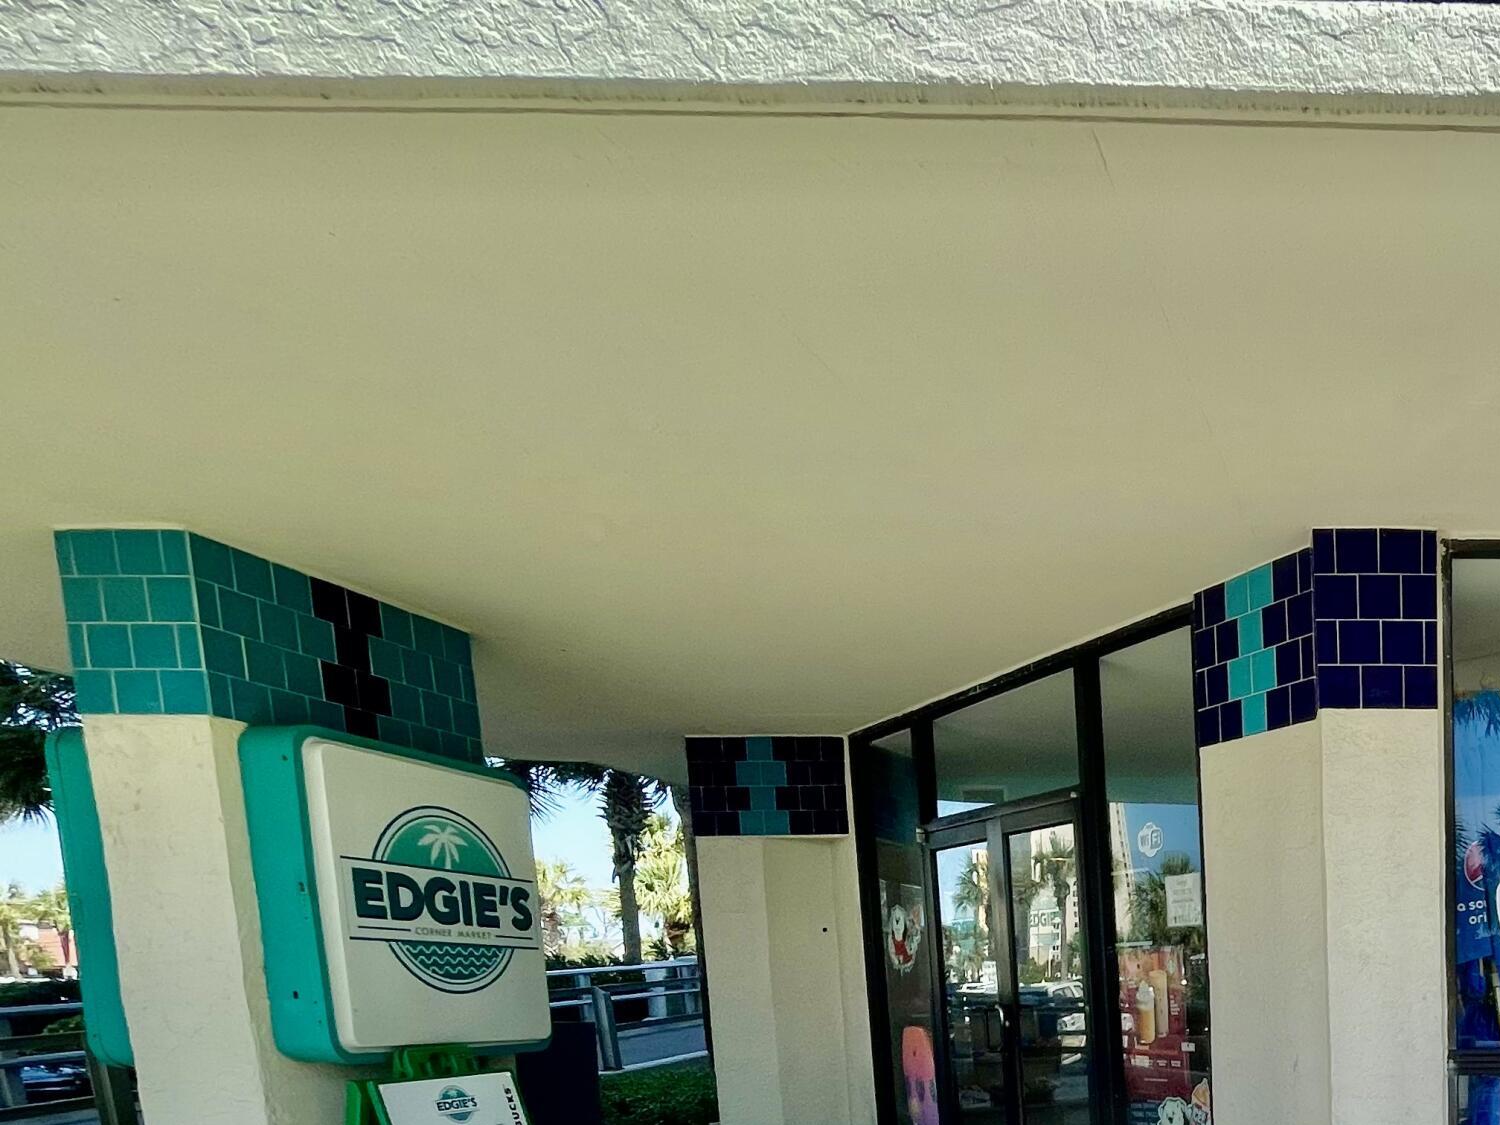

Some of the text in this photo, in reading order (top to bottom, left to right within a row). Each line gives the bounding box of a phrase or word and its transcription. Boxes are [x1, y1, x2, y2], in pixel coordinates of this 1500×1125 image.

[352, 867, 533, 932] EDGIE'S
[415, 927, 492, 940] CORNER MARKET
[436, 1097, 478, 1111] EDGIE'S
